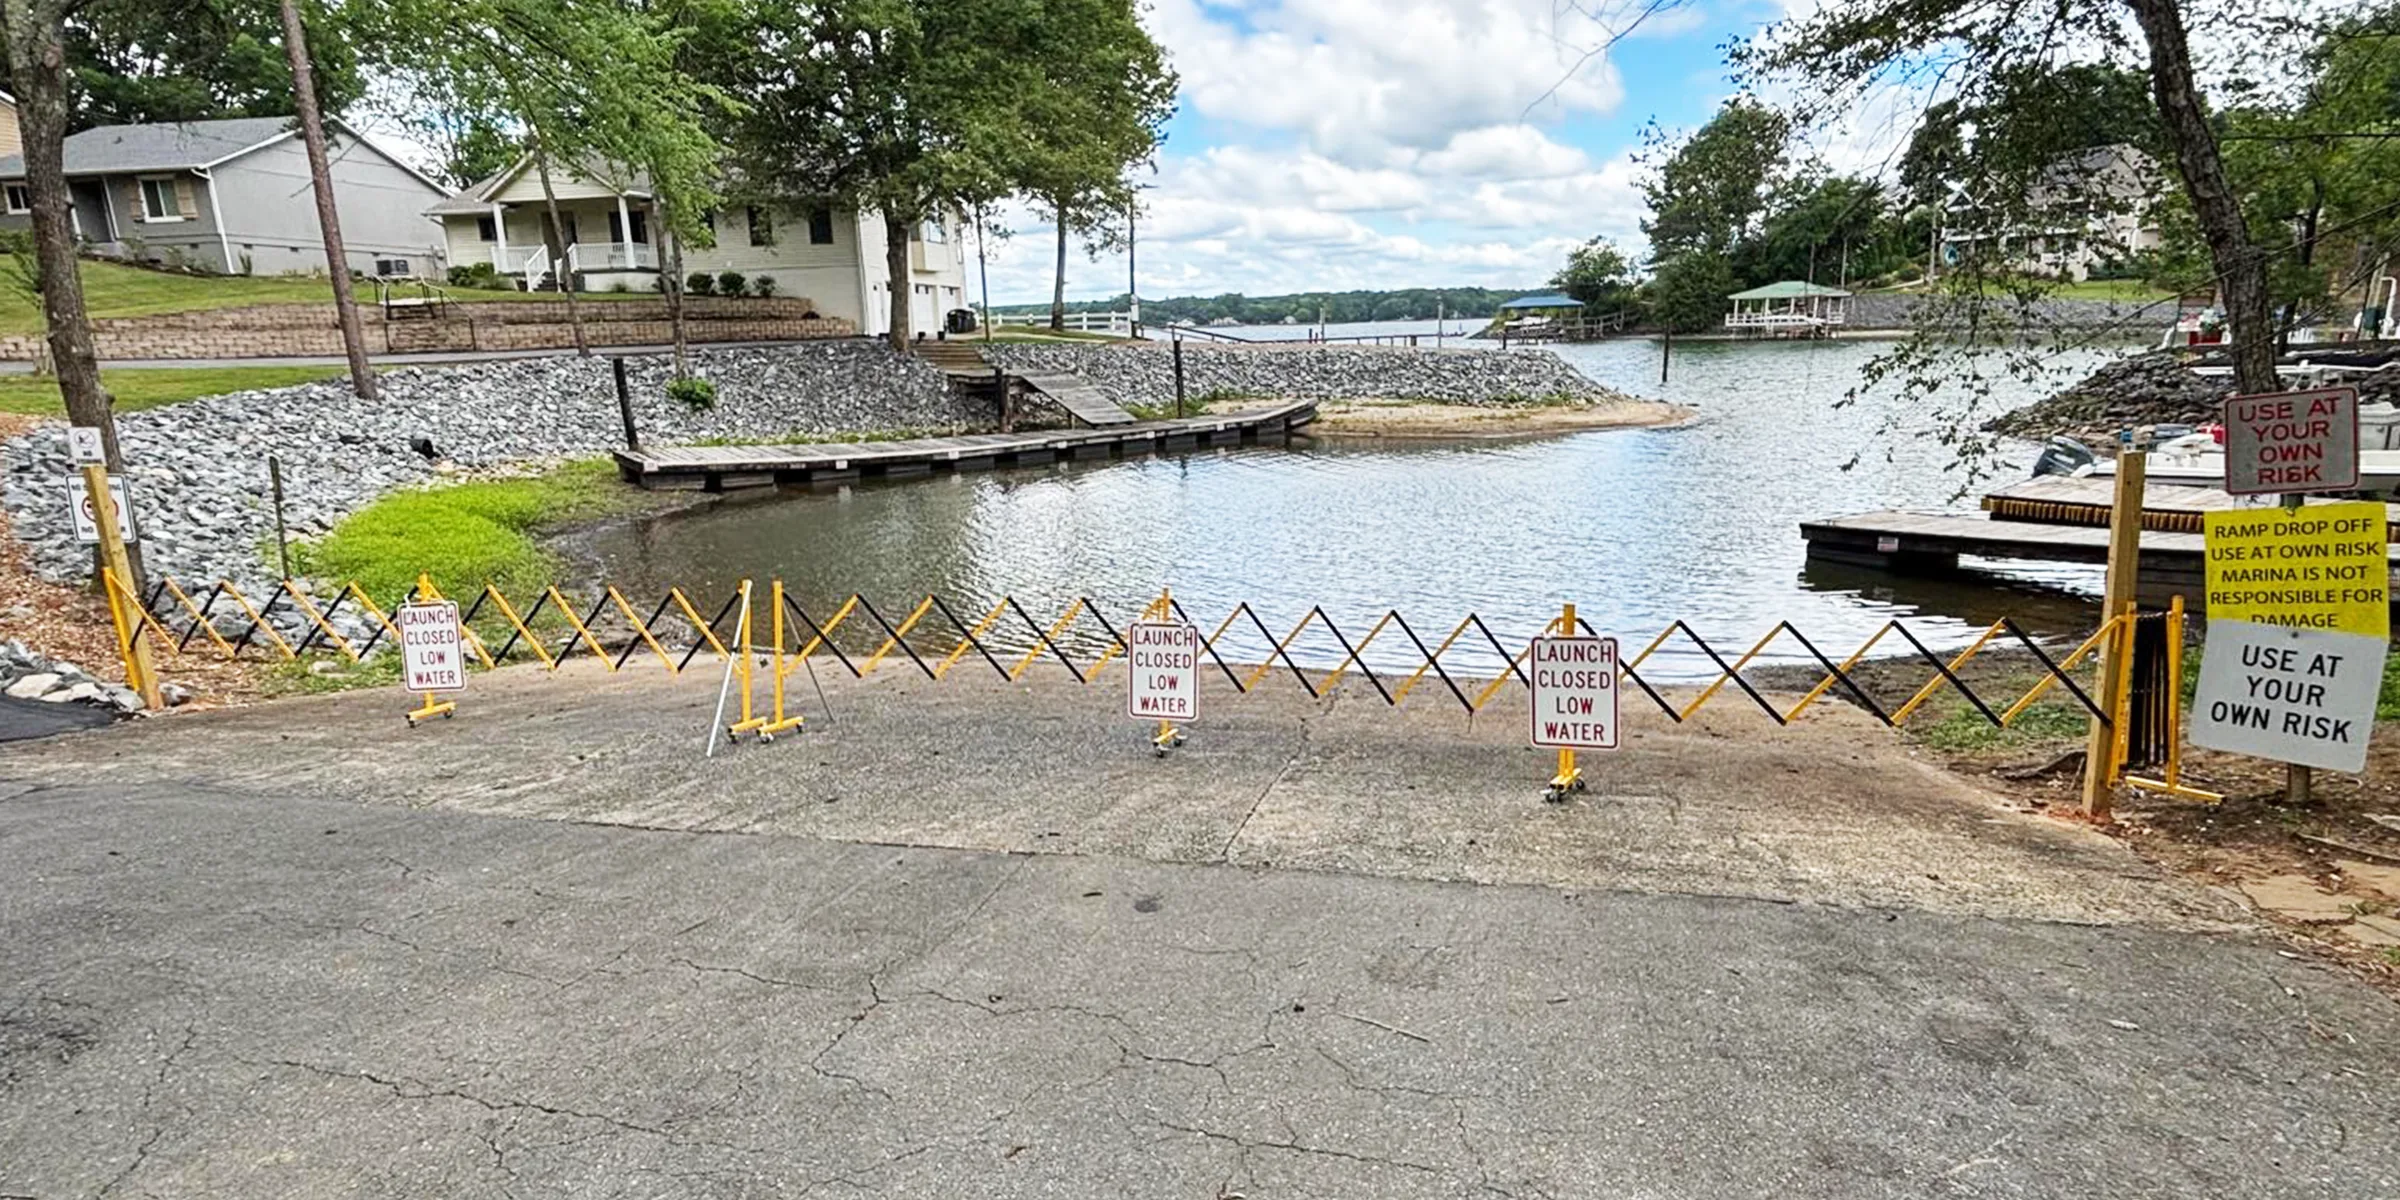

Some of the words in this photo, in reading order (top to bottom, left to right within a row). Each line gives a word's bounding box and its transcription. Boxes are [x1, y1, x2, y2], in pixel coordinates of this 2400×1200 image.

[2239, 402, 2293, 422] USE
[2307, 397, 2342, 416] AT
[2252, 420, 2330, 442] YOUR
[2259, 442, 2322, 463] OWN
[2258, 464, 2322, 484] RISK
[2215, 523, 2268, 539] RAMP
[2274, 521, 2328, 536] DROP
[2334, 518, 2373, 533] OFF
[2211, 547, 2245, 561] USE
[2250, 546, 2275, 559] AT
[2279, 544, 2329, 559] OWN
[2335, 542, 2380, 557] RISK
[2221, 568, 2297, 582] MARINA
[2303, 567, 2320, 580] IS
[2325, 565, 2369, 580] NOT
[2210, 589, 2336, 605] RESPONSIBLE
[2342, 588, 2383, 603] FOR
[403, 610, 454, 625] LAUNCH
[406, 630, 455, 645] CLOSED
[1135, 630, 1193, 646] LAUNCH
[420, 651, 445, 665] LOW
[1135, 652, 1192, 669] CLOSED
[1537, 643, 1612, 663] LAUNCH
[2242, 644, 2298, 672] USE
[2307, 654, 2343, 678] AT
[414, 670, 456, 685] WATER
[1149, 674, 1178, 690] LOW
[1538, 669, 1611, 689] CLOSED
[2247, 675, 2325, 707] YOUR
[1140, 696, 1187, 713] WATER
[1556, 696, 1593, 715] LOW
[1545, 722, 1605, 741] WATER
[2211, 701, 2270, 730] OWN
[2283, 712, 2352, 743] RISK
